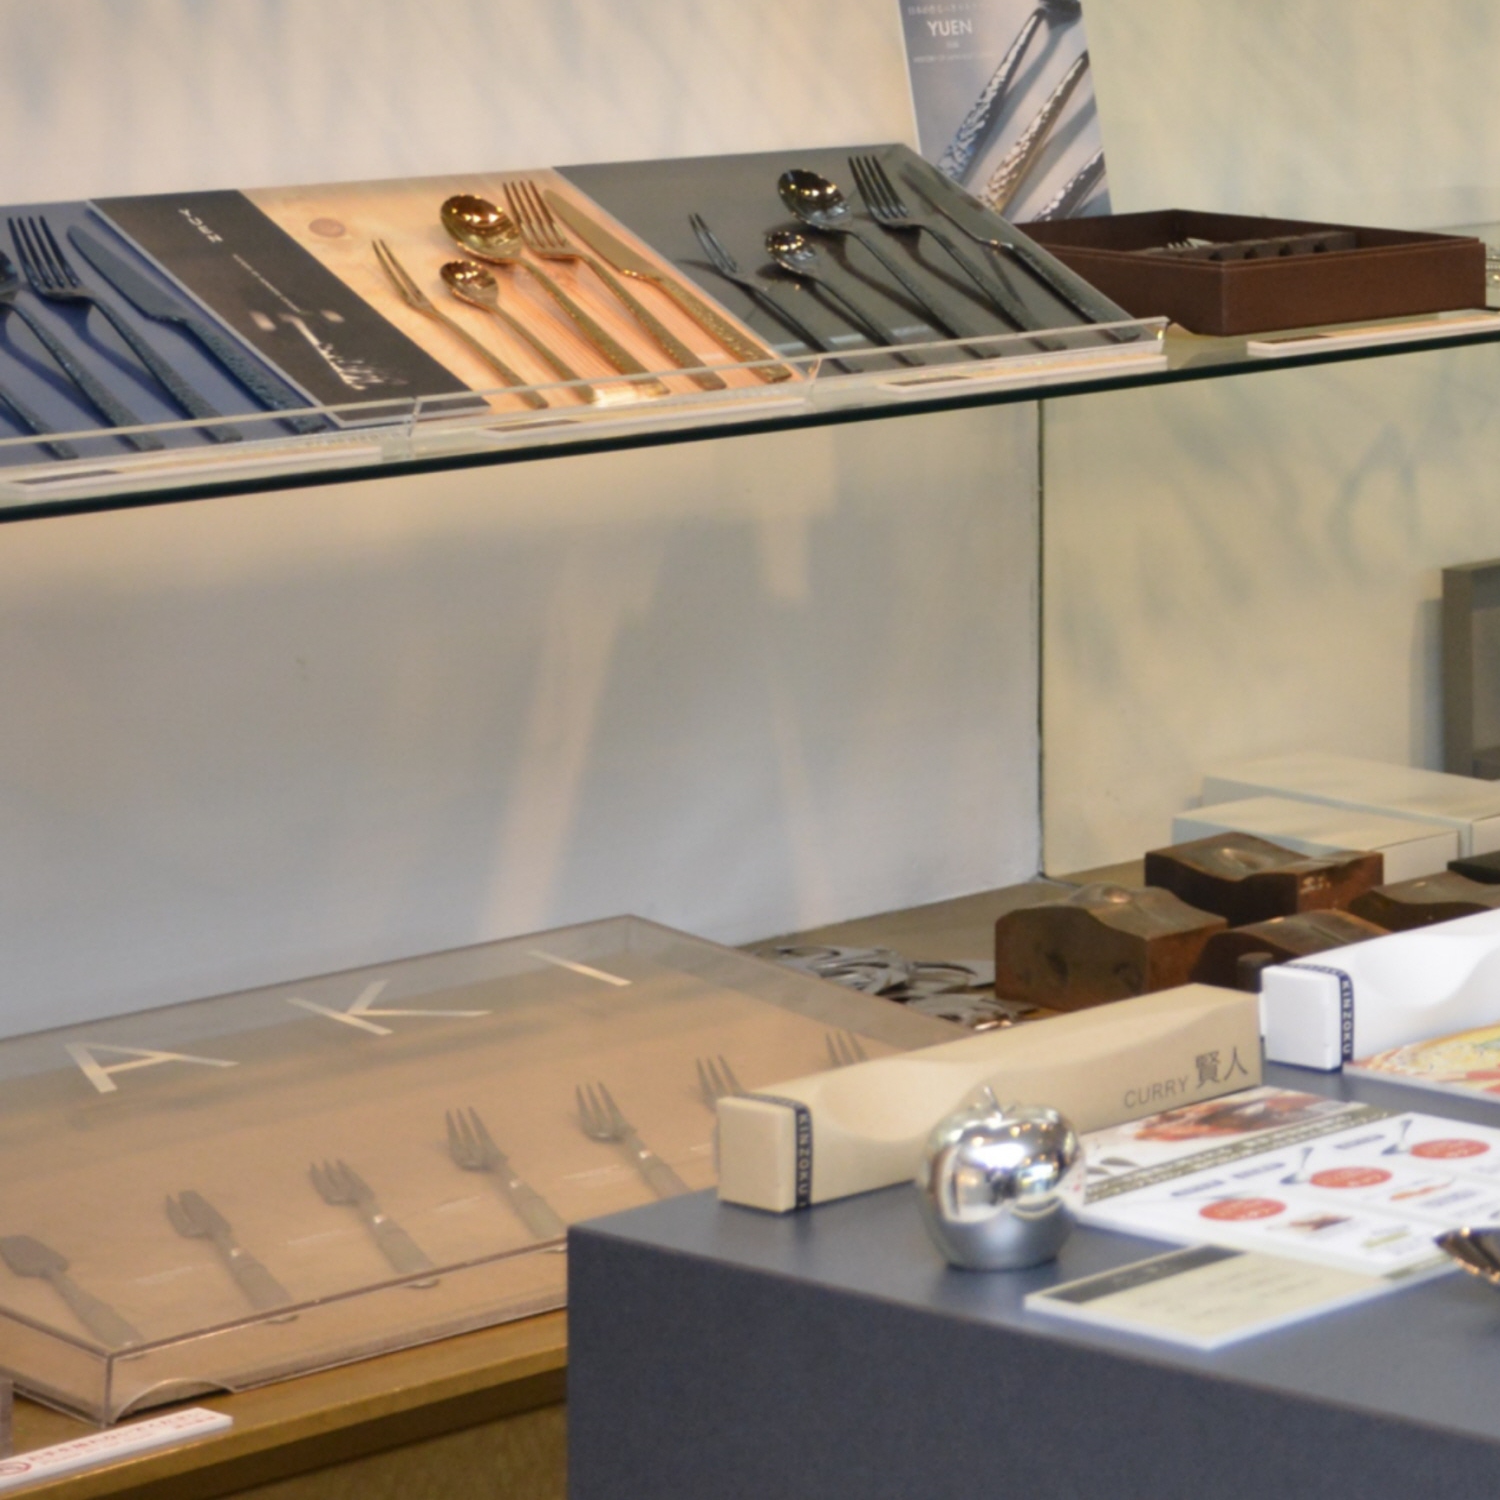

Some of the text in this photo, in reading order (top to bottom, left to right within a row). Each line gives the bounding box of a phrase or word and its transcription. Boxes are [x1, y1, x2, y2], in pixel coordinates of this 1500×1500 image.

[926, 18, 974, 38] YUEN
[1342, 980, 1352, 1056] KINZOKU
[1124, 1046, 1249, 1109] CURRY 賢人
